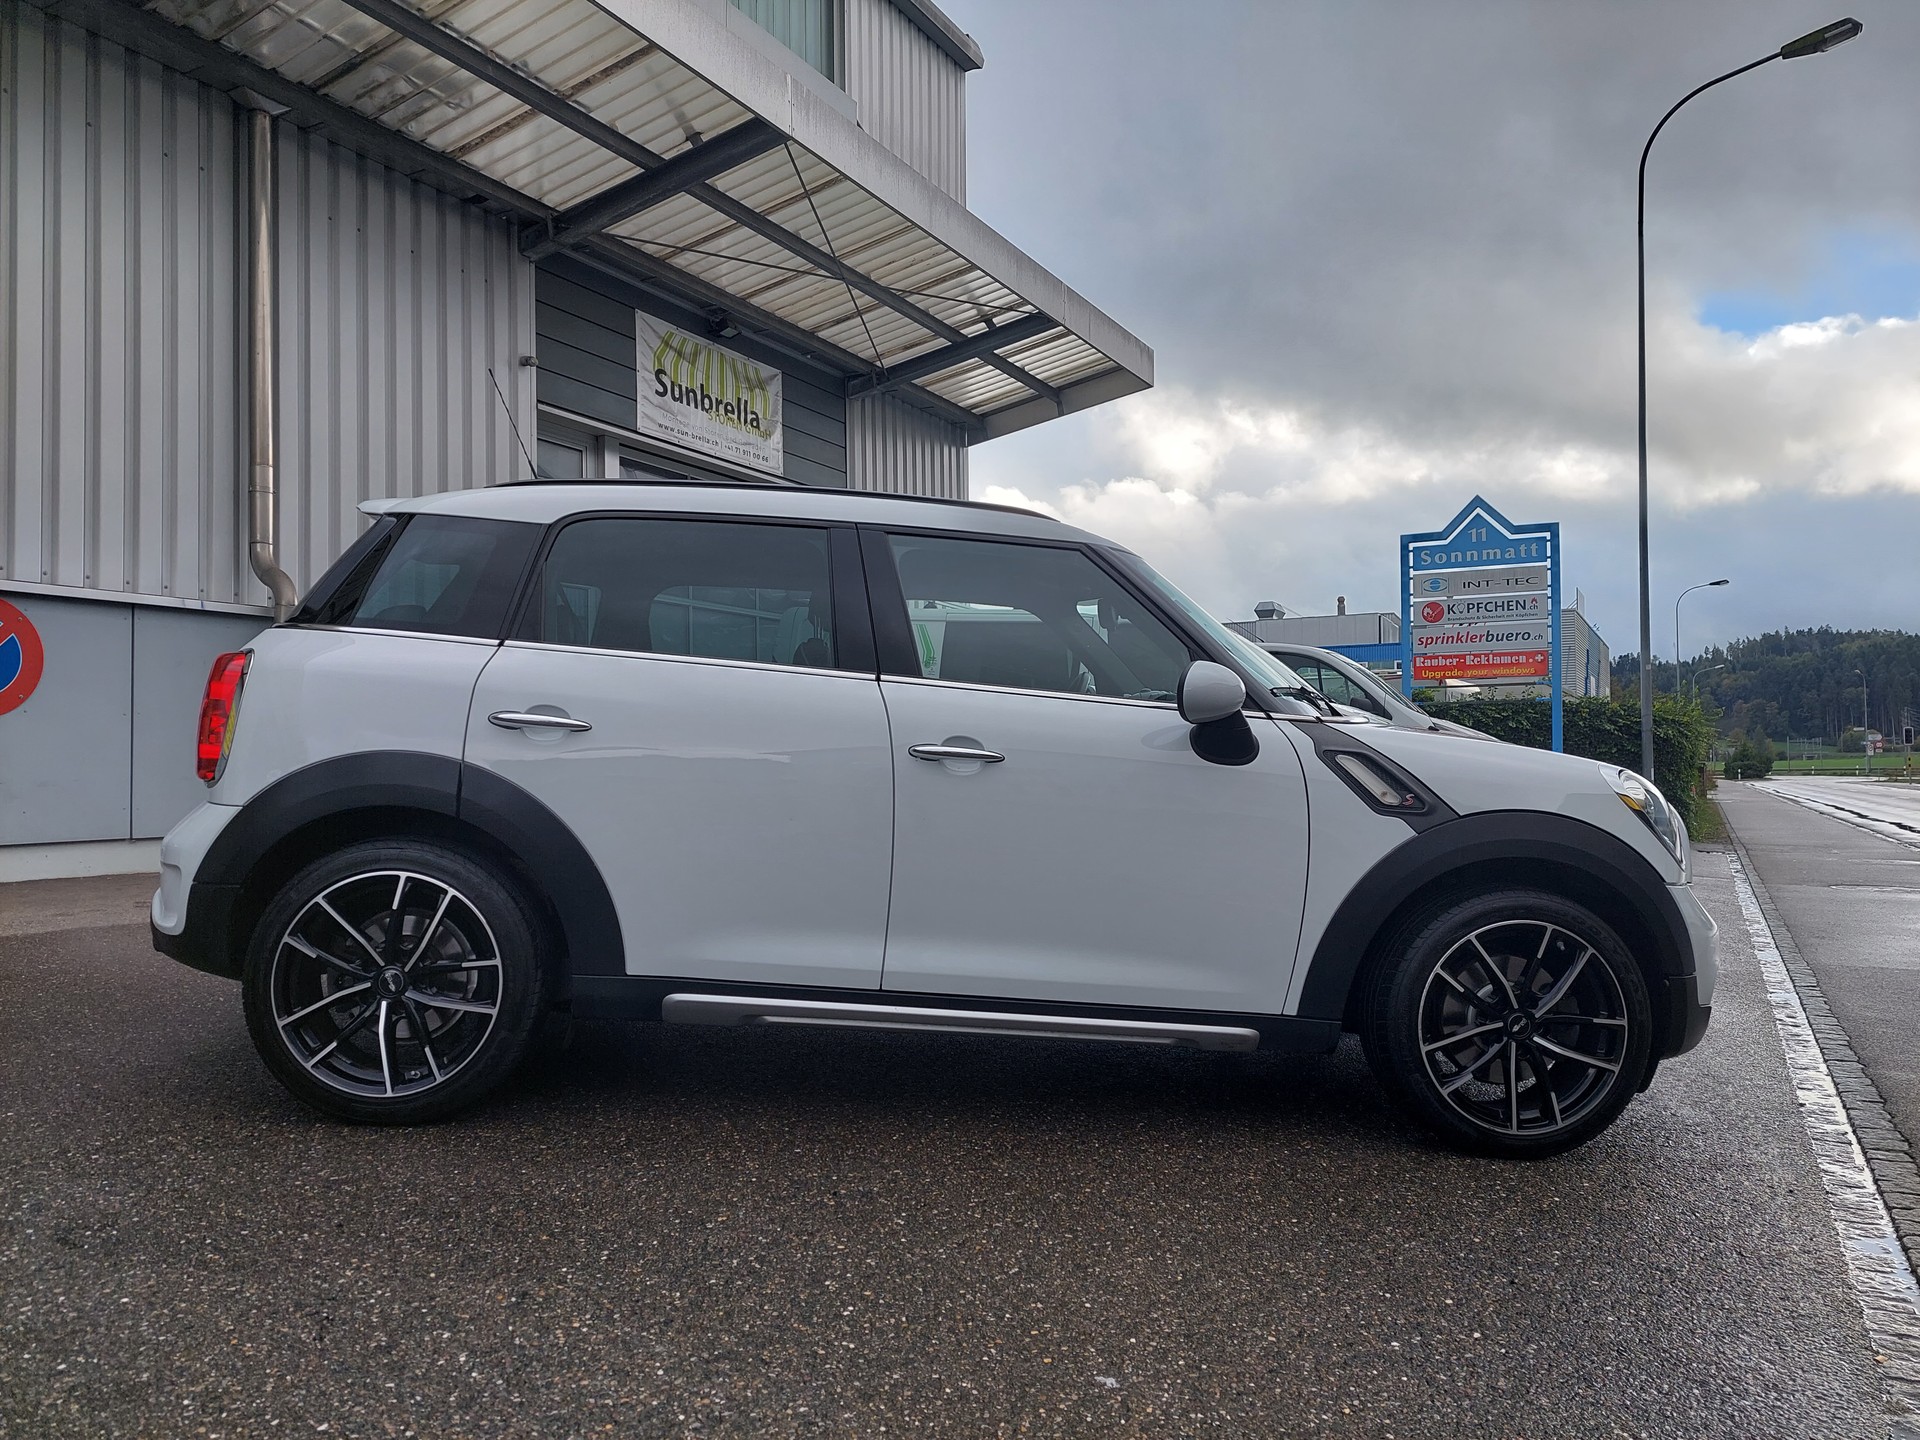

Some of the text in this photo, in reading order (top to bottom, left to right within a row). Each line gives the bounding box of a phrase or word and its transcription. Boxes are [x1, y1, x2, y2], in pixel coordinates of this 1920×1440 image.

[654, 368, 760, 431] Sunbrella
[657, 422, 719, 447] www.sun-brella.ch
[1467, 527, 1487, 542] 11
[1420, 542, 1539, 565] Sonnmatt
[1462, 576, 1539, 589] INT-TEC
[1417, 629, 1544, 648] sprinklerbuero.ch
[1421, 666, 1536, 679] Upgrade your windows
